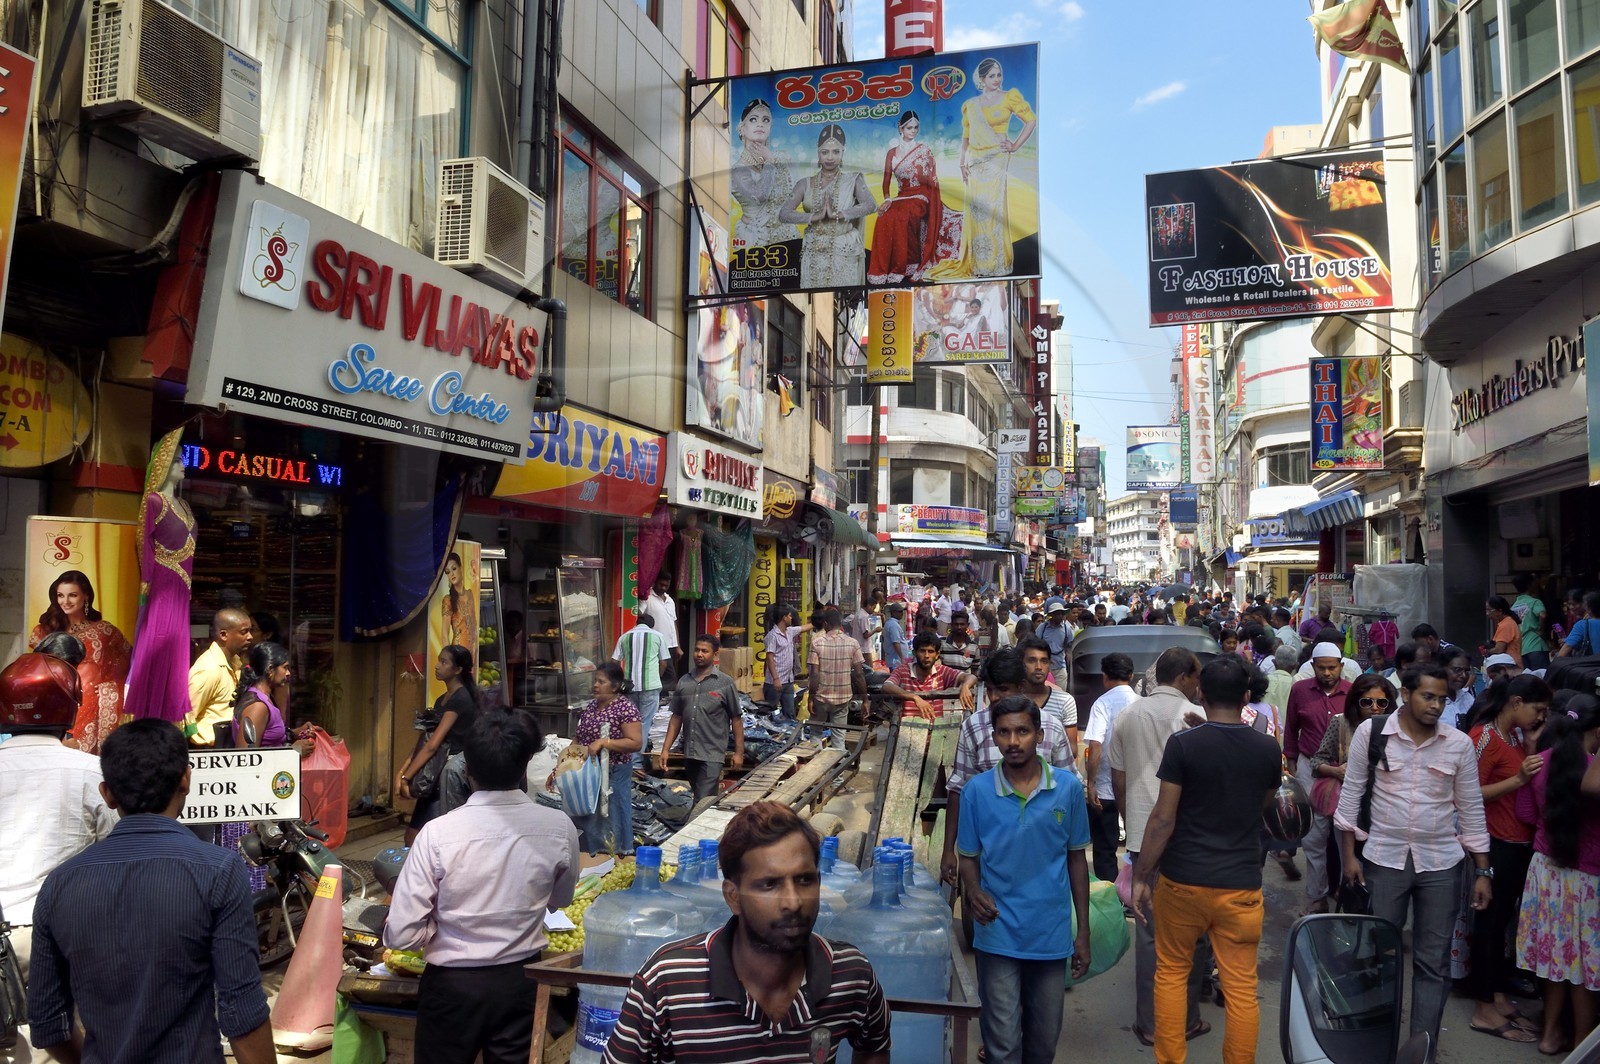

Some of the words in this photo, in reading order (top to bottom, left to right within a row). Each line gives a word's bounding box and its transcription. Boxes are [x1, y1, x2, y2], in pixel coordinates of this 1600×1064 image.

[889, 0, 936, 50] E
[732, 239, 746, 247] No
[732, 245, 789, 270] 133
[731, 271, 747, 279] 2nd
[747, 270, 770, 279] Cross
[770, 267, 799, 277] Street,
[731, 279, 766, 289] Colombo
[771, 278, 781, 287] 11
[1185, 295, 1231, 305] Wholesale
[1233, 293, 1240, 301] &
[1243, 290, 1270, 300] Retail
[1272, 288, 1307, 298] Dealers
[1321, 284, 1354, 294] Textile
[306, 239, 394, 331] SRI
[400, 272, 539, 381] VIJAYAS
[1175, 313, 1191, 321] 146,
[1192, 311, 1206, 319] 2nd
[1208, 309, 1229, 318] Cross
[1231, 306, 1257, 316] Street,
[1323, 301, 1339, 309] 011
[944, 331, 1007, 351] GAEL
[945, 352, 971, 360] SAREE
[973, 351, 1006, 360] MANDIR
[327, 342, 425, 402] Saree
[428, 370, 511, 425] Centre
[1315, 363, 1338, 443] THAI
[225, 382, 234, 394] #
[236, 385, 257, 400] 129,
[259, 390, 281, 404] 2ND
[283, 395, 319, 412] CROSS
[321, 403, 358, 421] STREET,
[360, 412, 402, 430] COLOMBO
[411, 423, 422, 435] 11,
[423, 426, 440, 438] TEL:
[440, 430, 456, 441] 0112
[480, 439, 491, 448] 011
[491, 442, 515, 454] 4879929
[1194, 376, 1212, 474] STARTAC
[526, 410, 660, 485] SRIYANI
[1317, 446, 1380, 458] Fashion
[218, 450, 310, 483] CASUAL
[1036, 455, 1050, 464] 151
[999, 455, 1008, 519] MESCO
[704, 487, 758, 513] TEXTILES
[918, 508, 947, 520] BEAUTY
[198, 782, 238, 796] FOR
[224, 802, 278, 818] BANK
